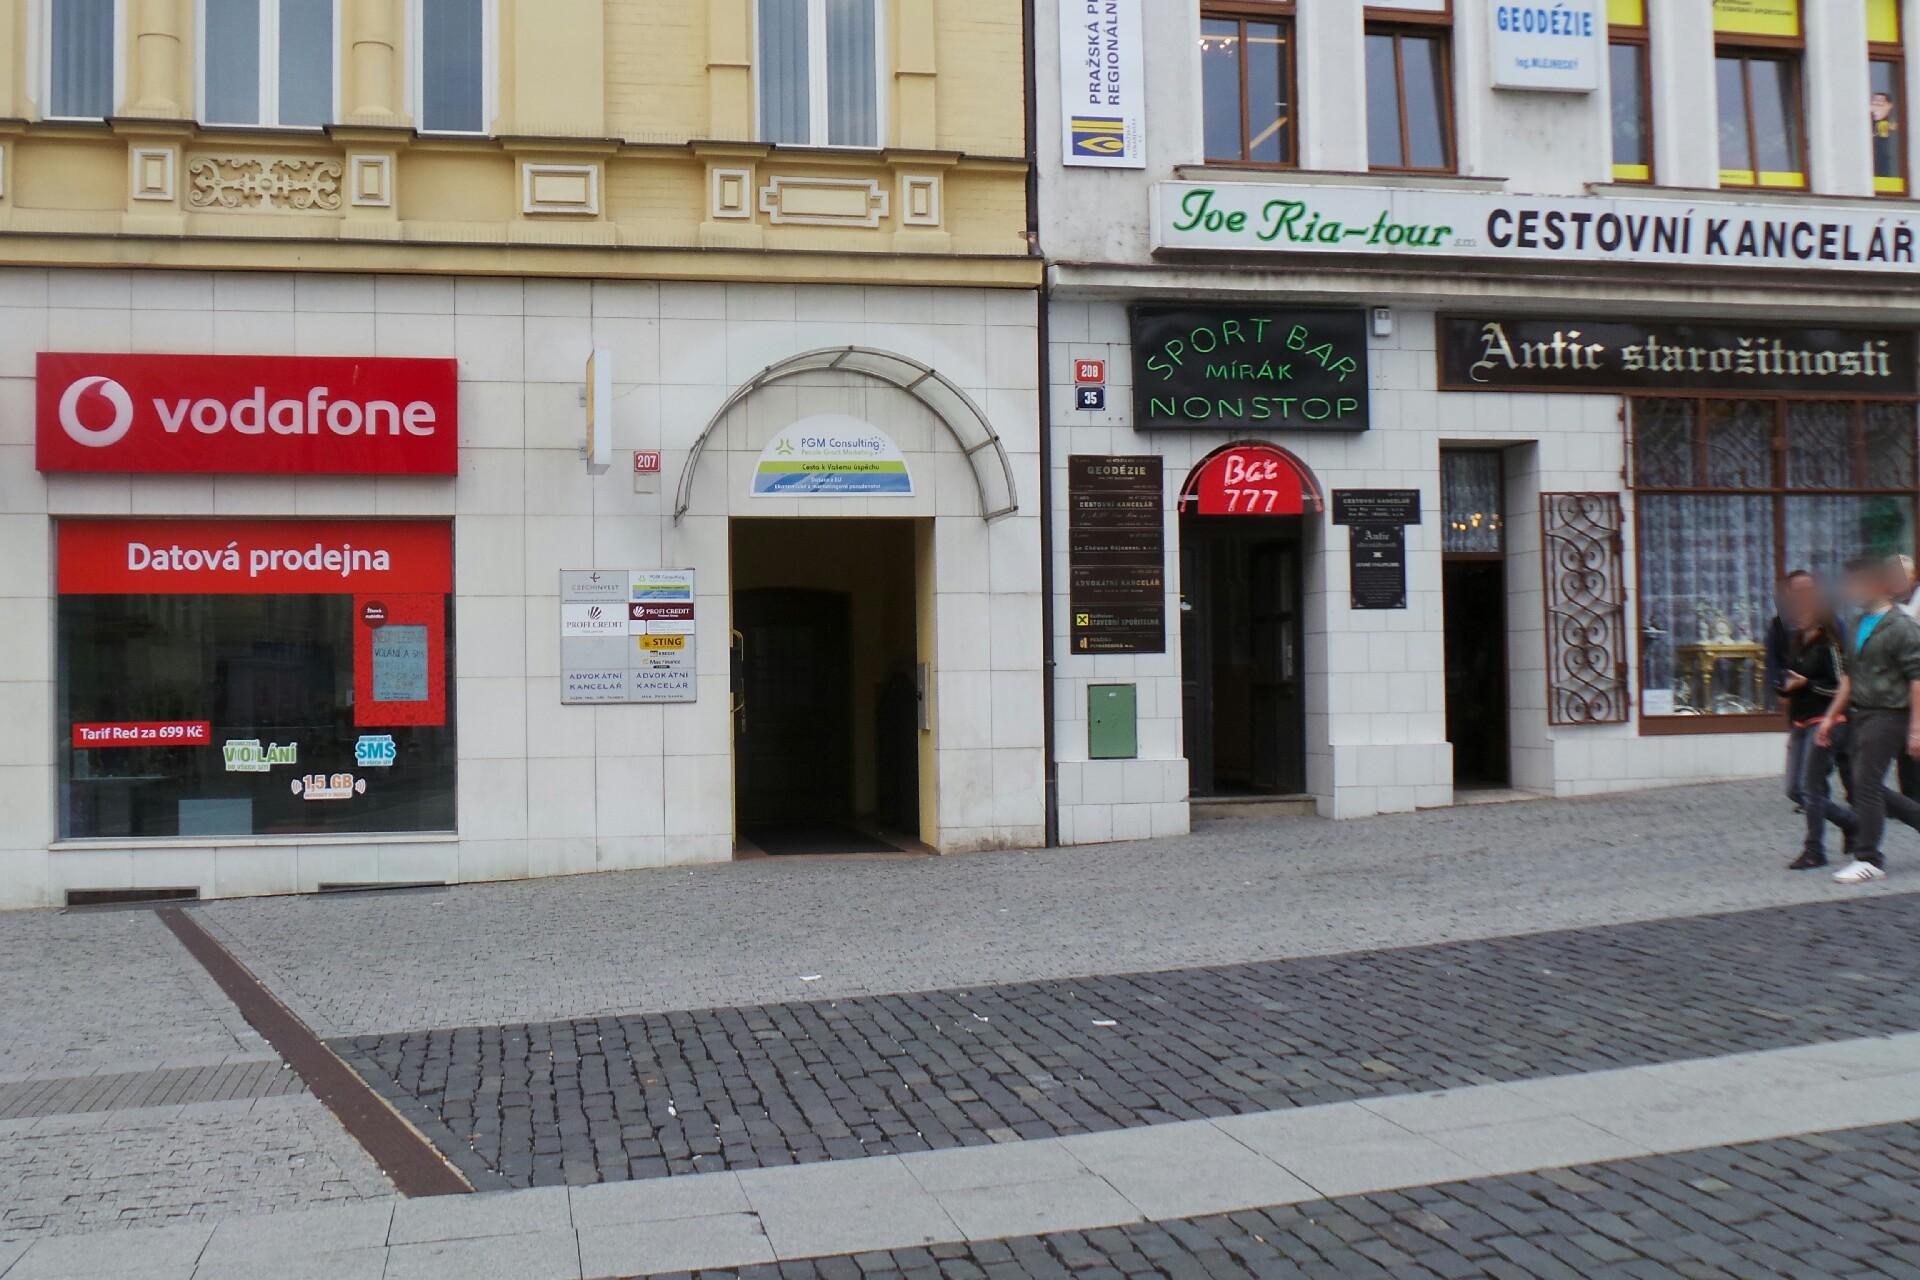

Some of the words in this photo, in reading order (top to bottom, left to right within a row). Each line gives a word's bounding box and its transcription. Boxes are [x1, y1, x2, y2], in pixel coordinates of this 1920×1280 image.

[1497, 3, 1592, 37] GEODÉZIE
[1104, 0, 1120, 106] REGIONÁLN
[1085, 22, 1101, 105] PRAŽSKÁ
[1173, 189, 1248, 232] Joe
[1487, 208, 1696, 255] CESTOVNÍ
[1705, 217, 1914, 264] KANCELÁŘ
[1147, 318, 1273, 381] SPORT
[1286, 324, 1358, 383] BAR
[1469, 321, 1606, 383] Antic
[1620, 333, 1893, 378] starožitnosti
[1081, 364, 1099, 378] 208
[1205, 359, 1294, 381] MÍRÁK
[1084, 391, 1098, 405] 35
[153, 386, 437, 437] vodafone
[1150, 396, 1359, 420] NONSTOP
[801, 438, 826, 448] PGM
[829, 437, 880, 451] Consulting
[637, 454, 657, 468] 207
[802, 463, 820, 471] Cesta
[827, 463, 852, 471] Vašemu
[853, 463, 880, 473] úspěchu
[1087, 465, 1147, 475] GEODÉZIE
[1223, 488, 1279, 514] 777
[127, 541, 240, 571] Datová
[249, 543, 391, 578] prodejna
[566, 621, 591, 629] PROFI
[652, 637, 682, 646] STING
[636, 671, 689, 679] ADVOKÁTNÍ
[569, 682, 623, 690] KANCELÁŘ
[636, 681, 689, 689] KANCELÁŘ
[80, 727, 112, 740] Tarif
[113, 726, 138, 739] Red
[141, 728, 156, 738] za
[159, 726, 184, 738] 699
[187, 725, 203, 737] Kč
[356, 742, 395, 759] SMS
[303, 775, 325, 792] 1,5
[331, 774, 354, 790] GB
